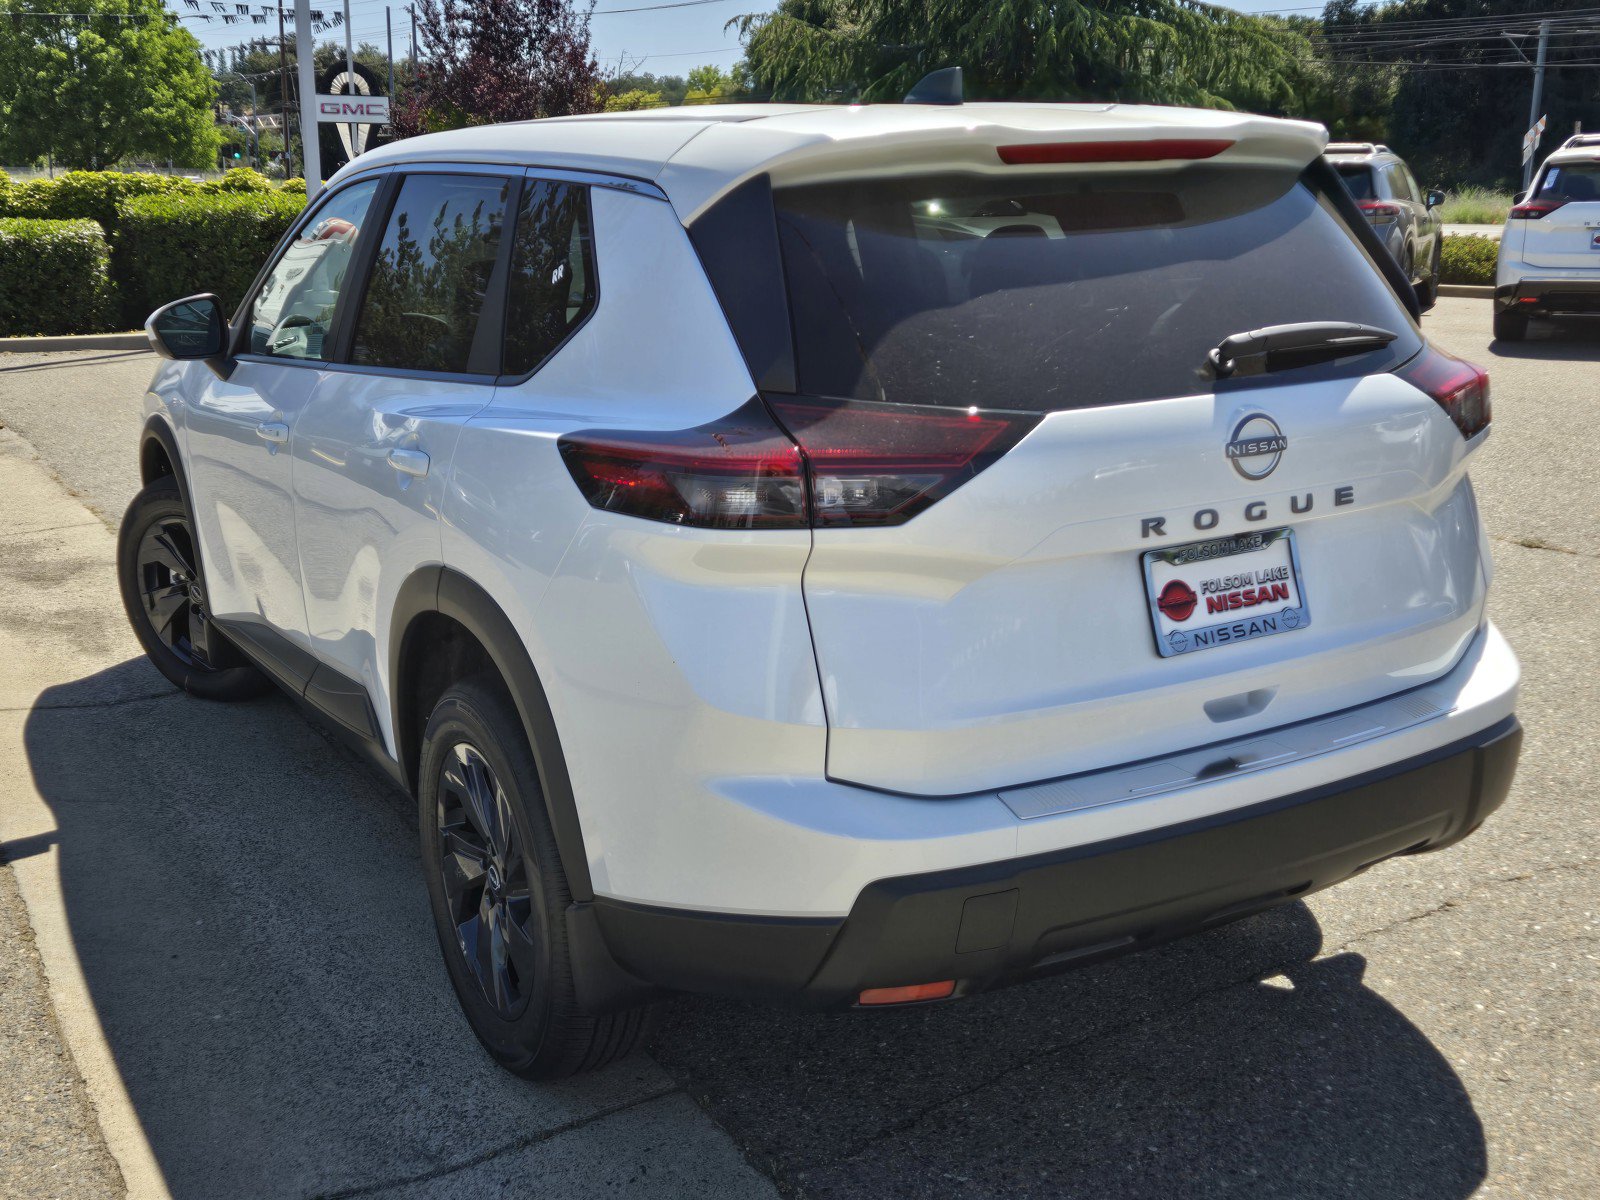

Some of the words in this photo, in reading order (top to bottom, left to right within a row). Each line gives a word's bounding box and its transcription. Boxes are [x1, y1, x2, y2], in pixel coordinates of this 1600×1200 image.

[320, 103, 384, 115] GMC
[1228, 437, 1288, 457] NISSAN
[1141, 485, 1355, 538] ROGUE
[1180, 541, 1230, 563] FOLSOM
[1230, 534, 1263, 551] LAKE
[1200, 571, 1252, 594] FOLSOM
[1255, 565, 1290, 584] LAKE
[1205, 582, 1290, 614] NISSAN
[1193, 617, 1277, 647] NISSAN
